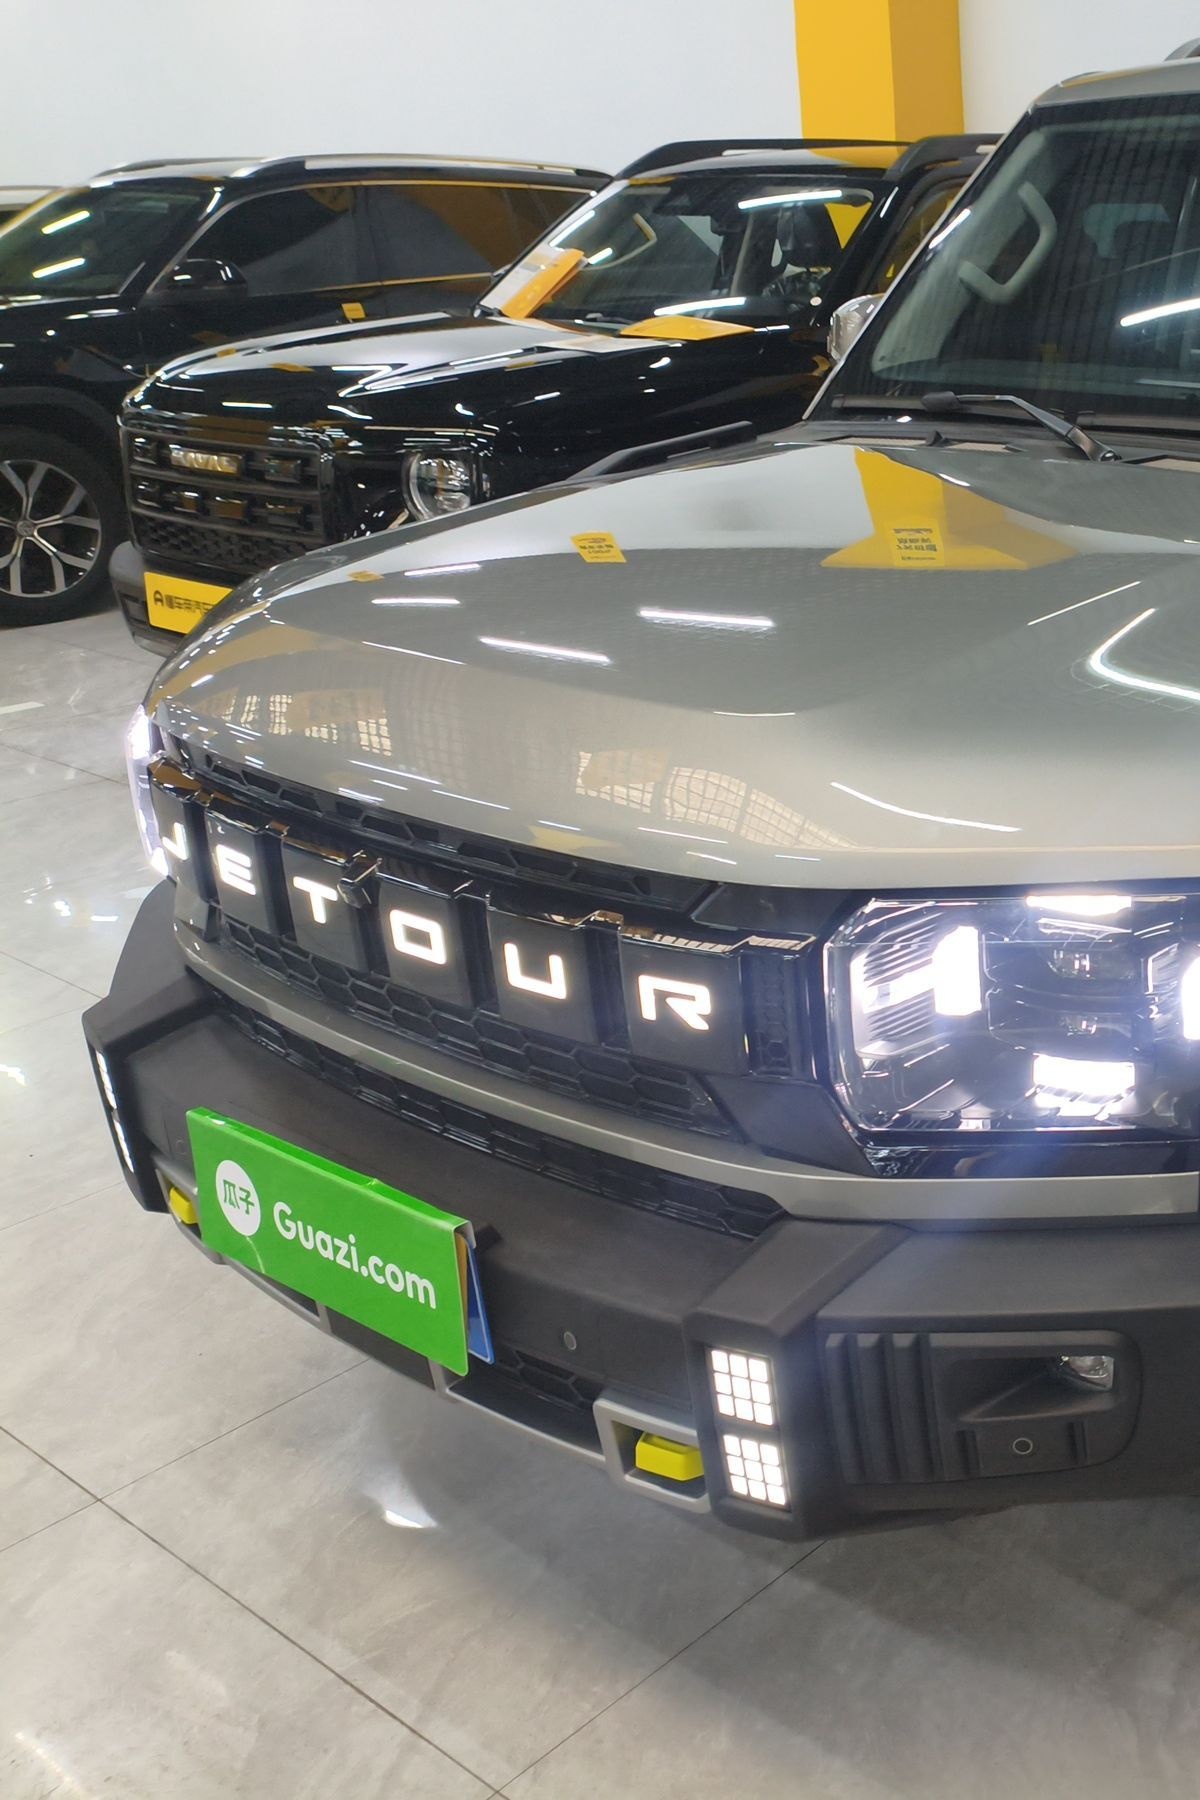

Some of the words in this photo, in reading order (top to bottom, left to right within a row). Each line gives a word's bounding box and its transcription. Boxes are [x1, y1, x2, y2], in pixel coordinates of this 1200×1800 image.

[162, 822, 712, 1031] JETOUR
[222, 1179, 255, 1216] 瓜子
[273, 1201, 437, 1309] Guazi.com
